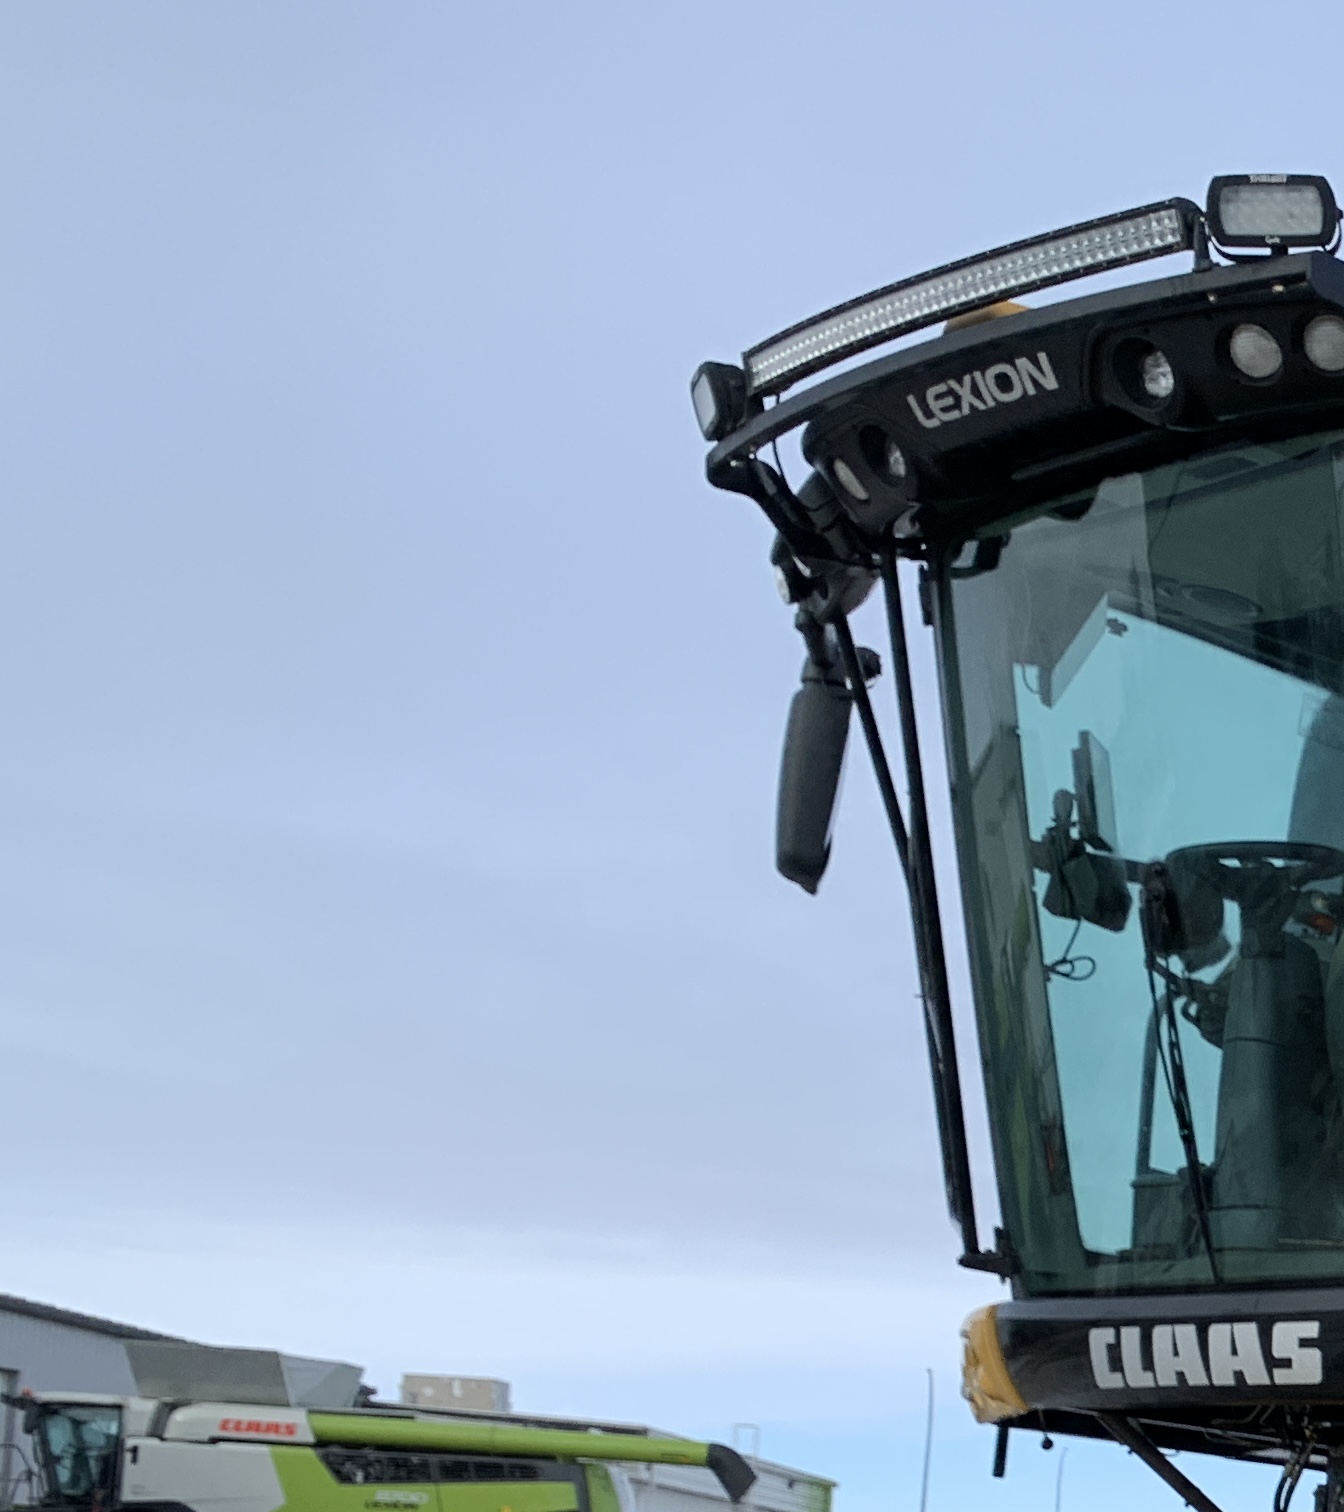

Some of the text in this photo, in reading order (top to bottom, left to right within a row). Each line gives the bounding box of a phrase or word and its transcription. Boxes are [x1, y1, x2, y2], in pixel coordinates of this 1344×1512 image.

[906, 351, 1060, 429] LEXION
[1088, 1320, 1323, 1389] CLAAS
[219, 1418, 297, 1437] CLAAS
